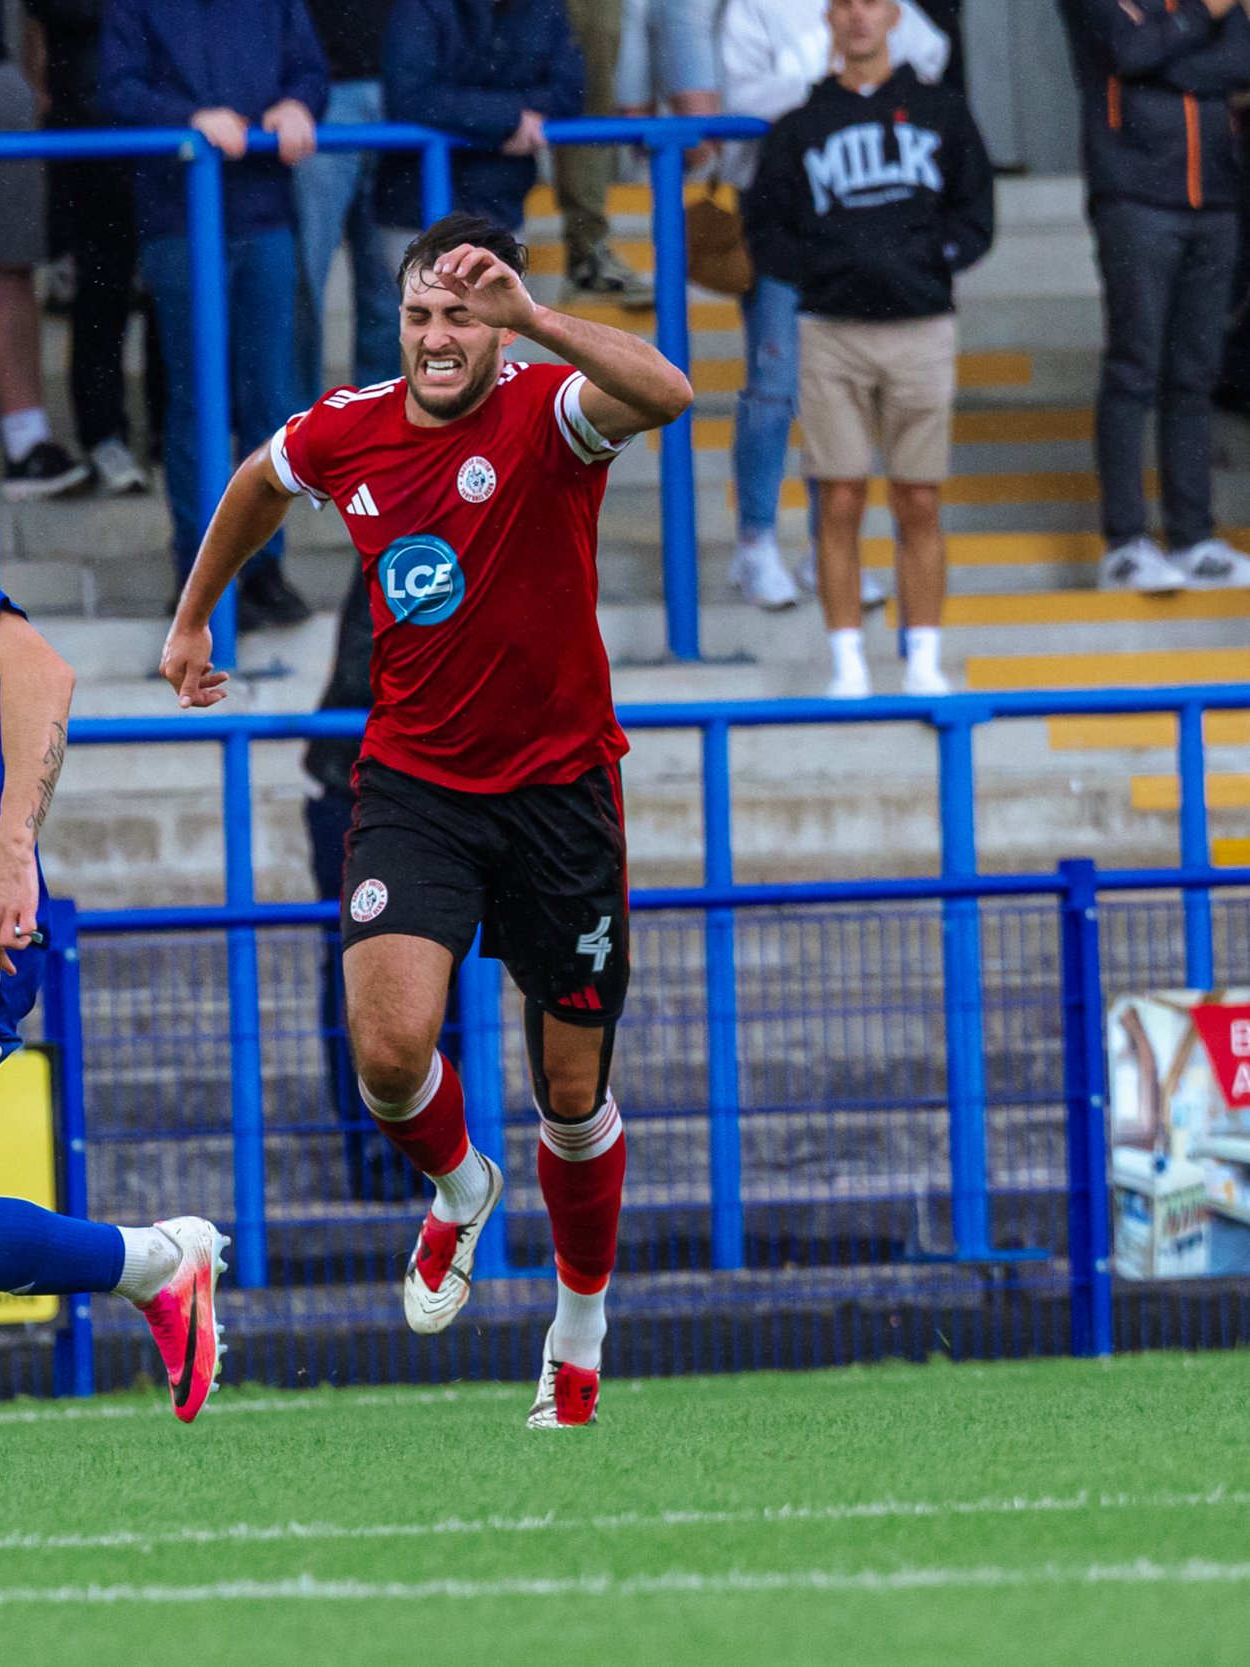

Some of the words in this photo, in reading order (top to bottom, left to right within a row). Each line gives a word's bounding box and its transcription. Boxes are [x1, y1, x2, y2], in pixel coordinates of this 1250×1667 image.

[804, 121, 943, 216] MILK
[386, 562, 453, 599] LCE
[576, 915, 612, 973] 4
